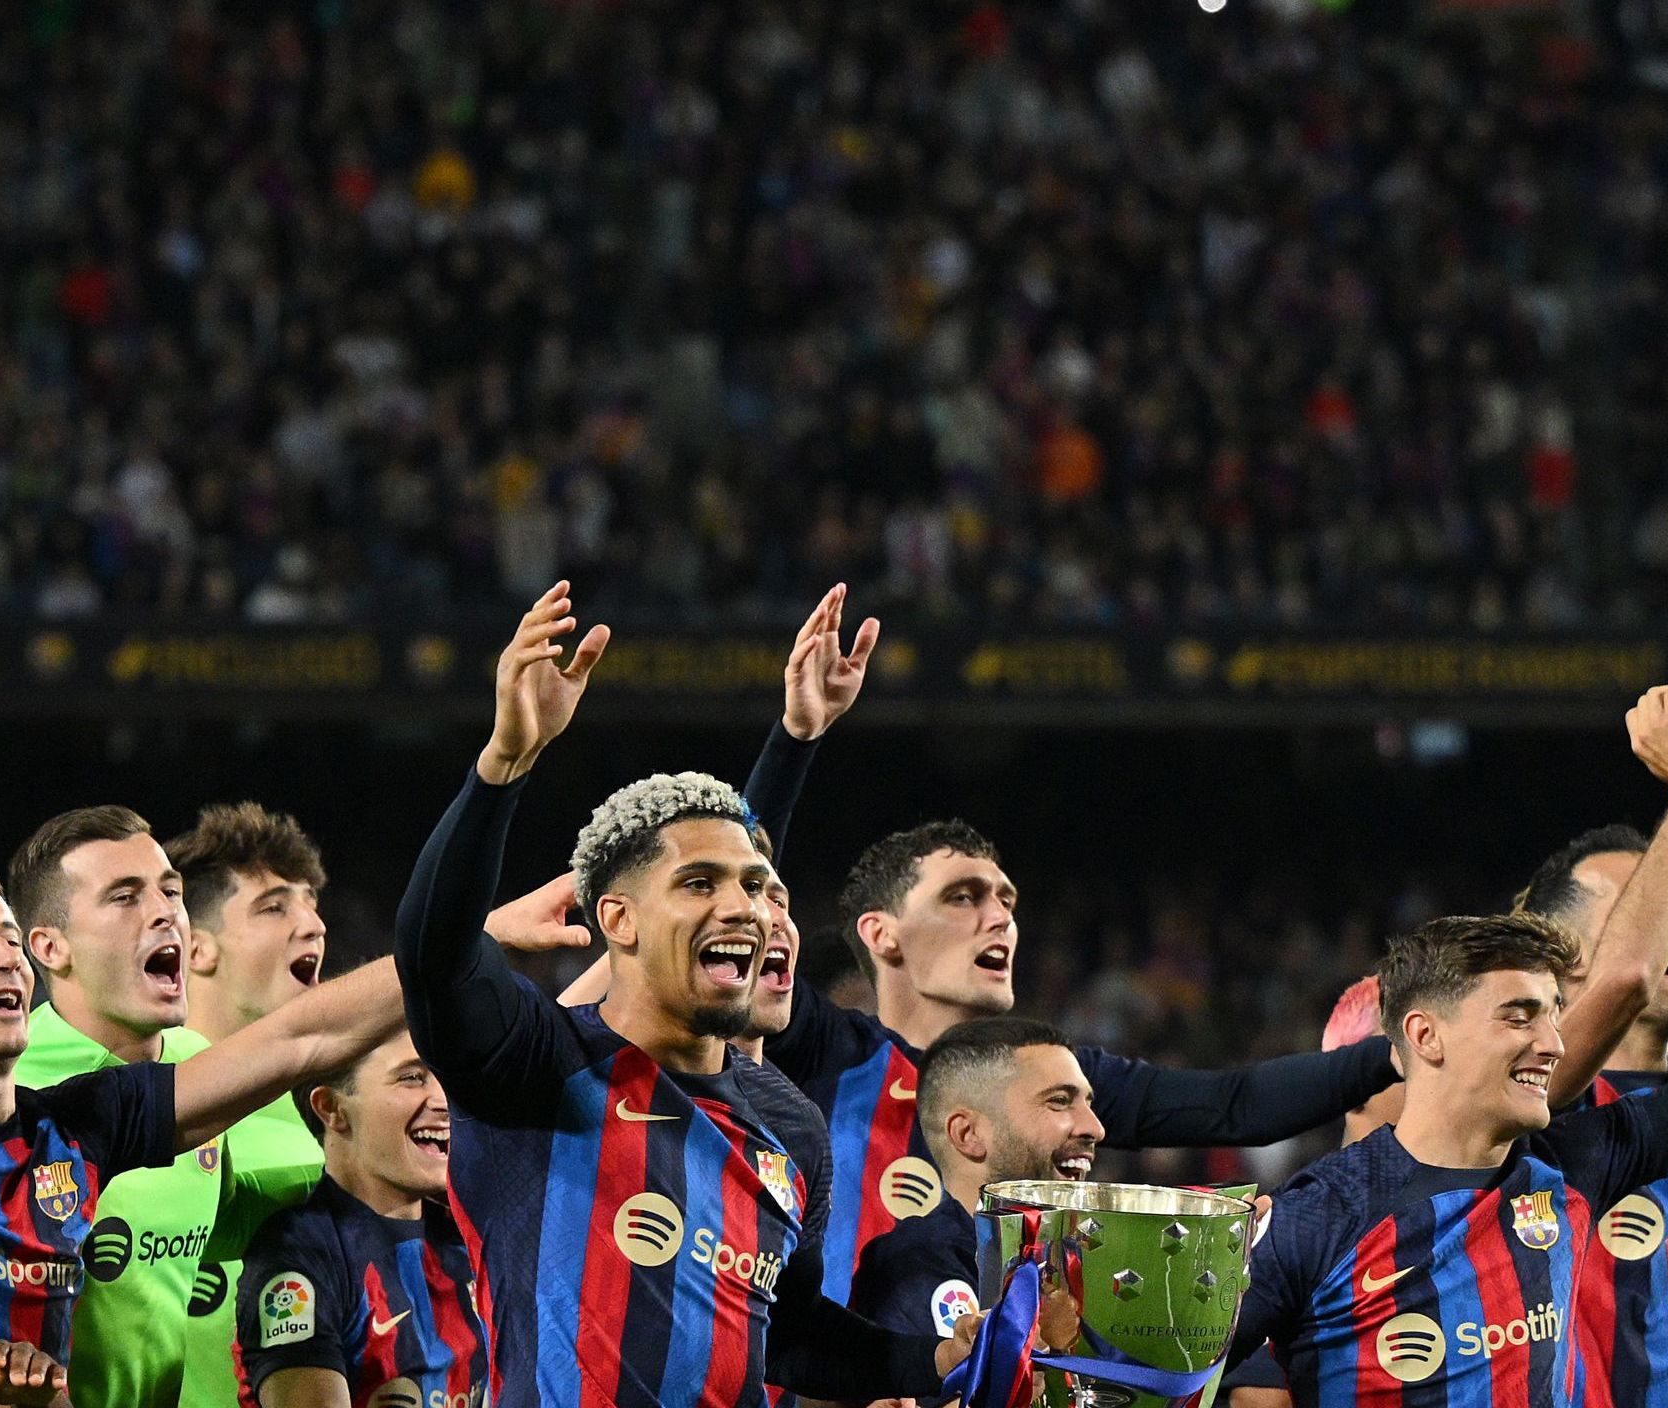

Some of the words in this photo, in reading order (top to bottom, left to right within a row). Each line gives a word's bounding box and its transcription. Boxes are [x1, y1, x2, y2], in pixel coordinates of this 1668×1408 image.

[137, 1226, 208, 1266] Spotif
[266, 1321, 309, 1339] LaLiga
[1456, 1302, 1564, 1359] Spotify
